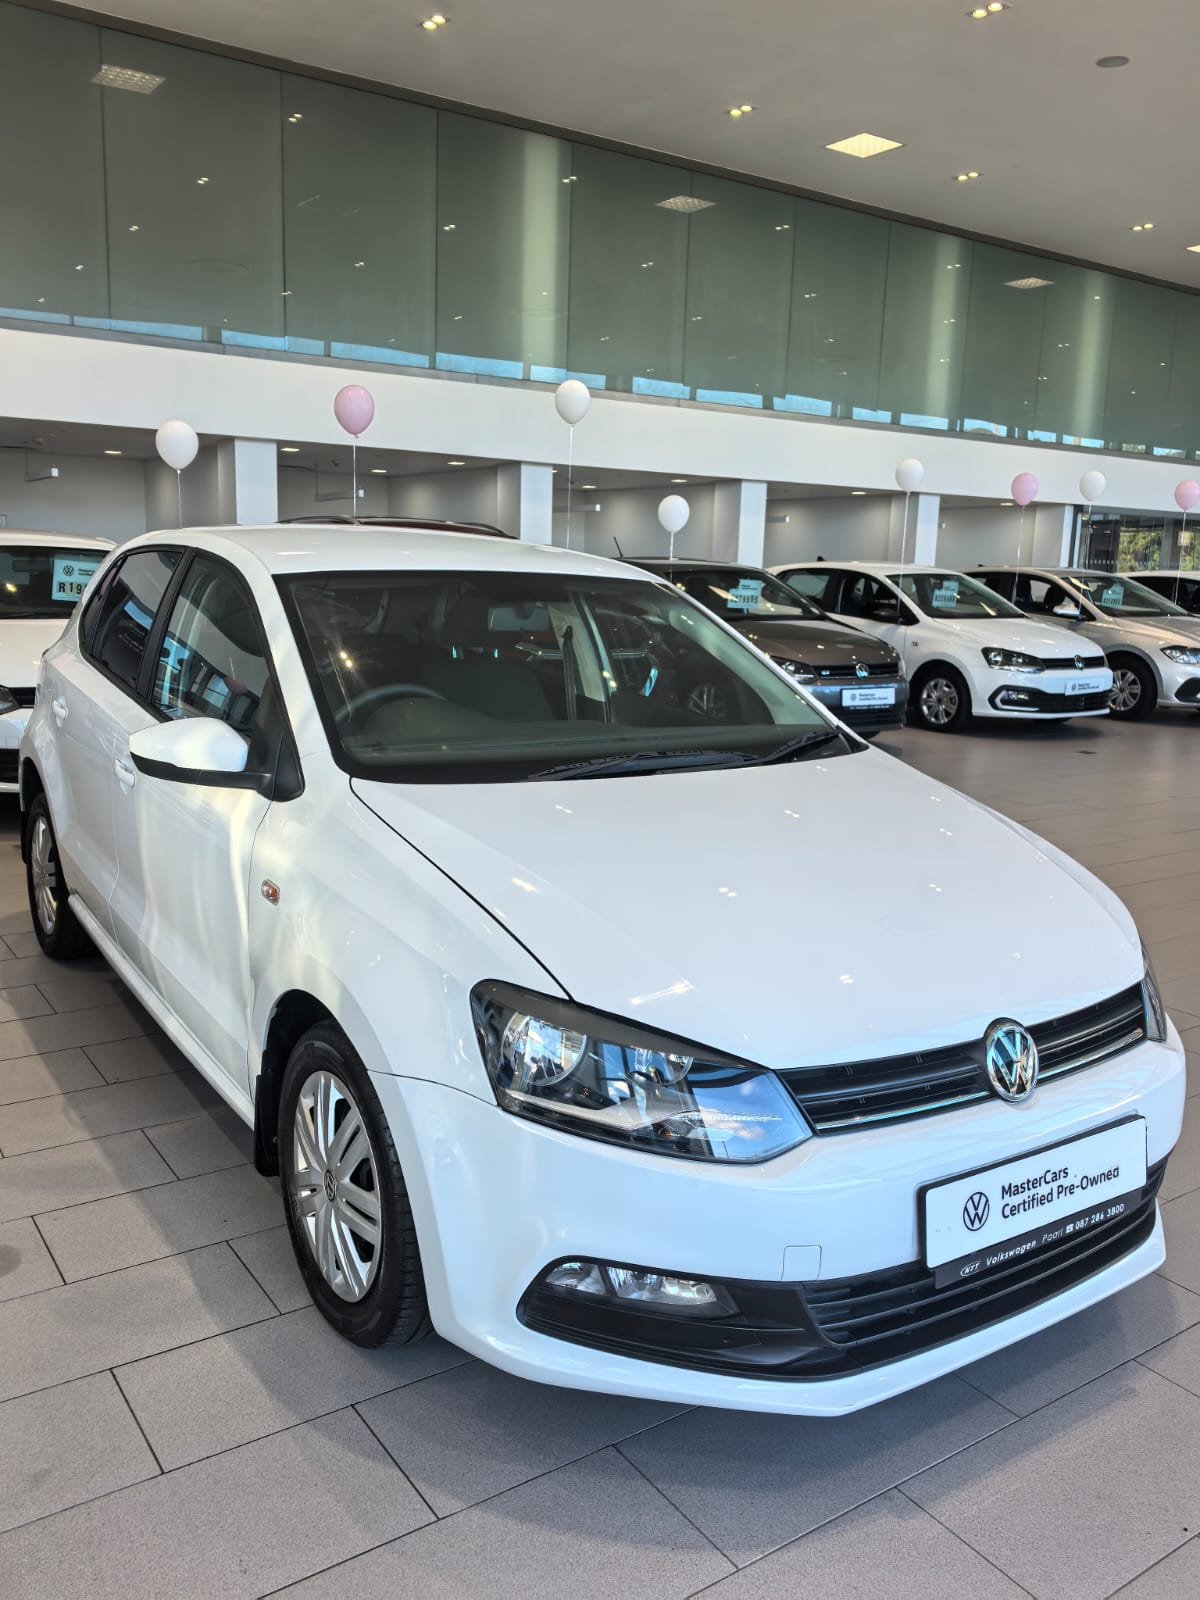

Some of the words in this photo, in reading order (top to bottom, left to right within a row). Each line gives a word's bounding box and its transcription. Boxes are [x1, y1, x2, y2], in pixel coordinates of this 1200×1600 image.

[1001, 1166, 1069, 1200] MasterCars
[1001, 1189, 1053, 1219] Certified
[1056, 1166, 1120, 1199] Pre-Owned
[986, 1240, 1037, 1267] Volkswagen
[1075, 1219, 1089, 1230] 087
[1106, 1203, 1125, 1218] 3800
